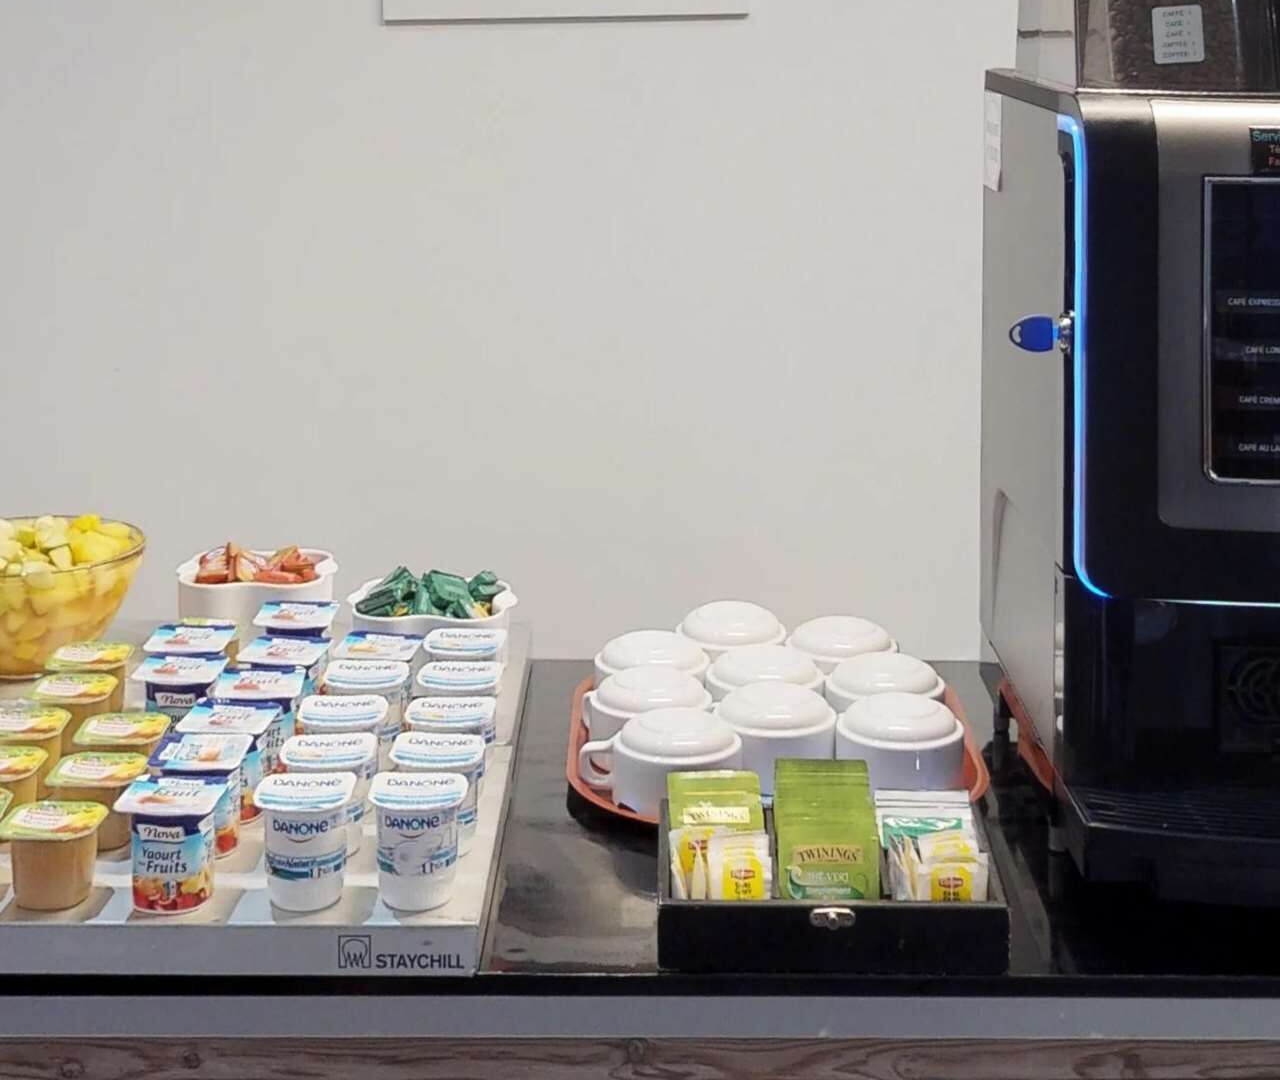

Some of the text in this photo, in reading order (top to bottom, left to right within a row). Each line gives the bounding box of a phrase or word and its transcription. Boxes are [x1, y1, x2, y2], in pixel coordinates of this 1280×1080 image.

[142, 847, 182, 861] Yaourt
[797, 846, 857, 862] TWININGS
[146, 860, 188, 874] Fruits
[375, 953, 465, 969] STAYCHILL
